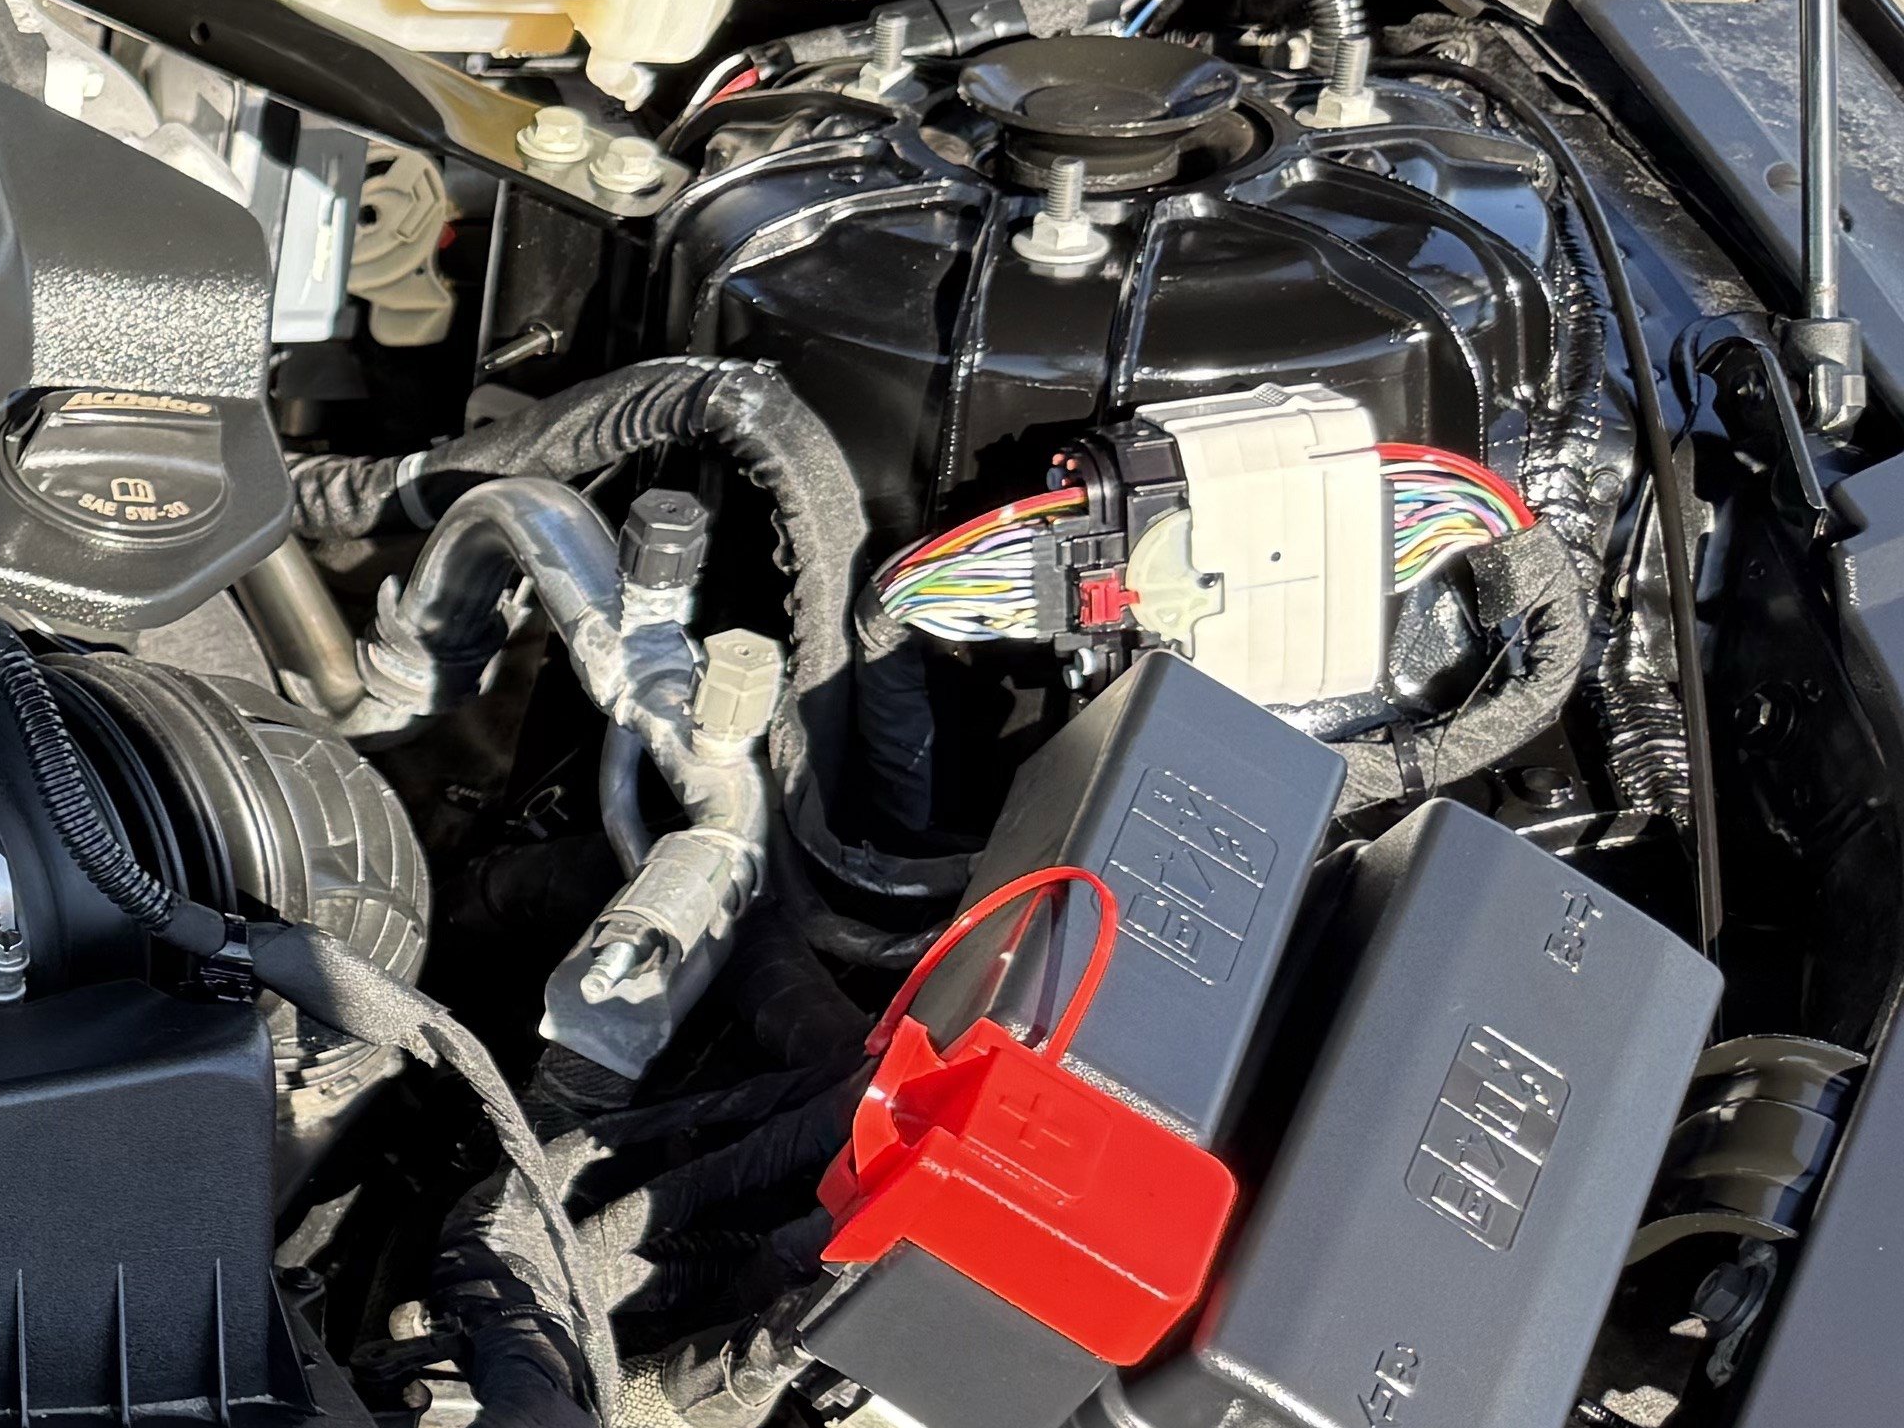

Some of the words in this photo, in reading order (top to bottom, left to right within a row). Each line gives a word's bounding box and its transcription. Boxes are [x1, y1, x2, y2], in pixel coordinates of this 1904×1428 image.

[60, 392, 213, 415] ACDelco
[77, 492, 118, 517] SAE
[124, 500, 191, 521] 5W-30
